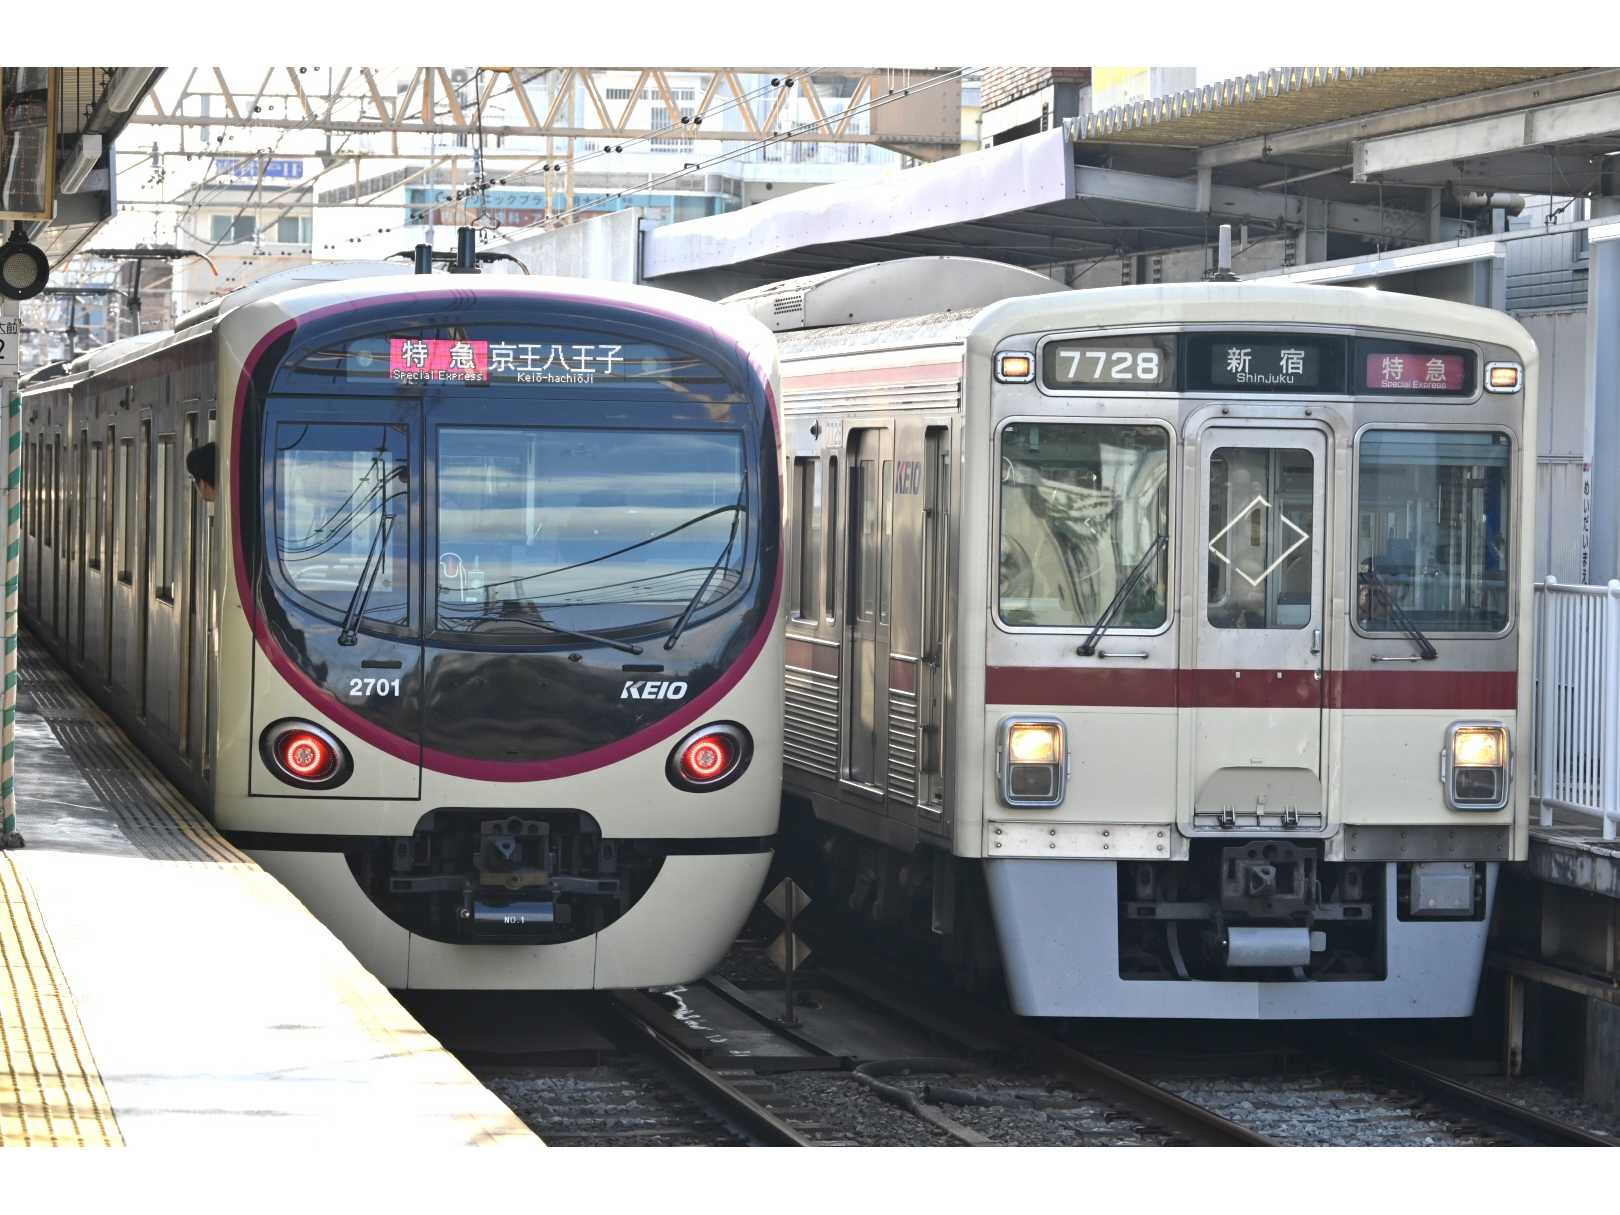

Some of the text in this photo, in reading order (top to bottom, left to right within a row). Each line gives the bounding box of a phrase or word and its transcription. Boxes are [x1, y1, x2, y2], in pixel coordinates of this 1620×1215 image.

[402, 340, 476, 368] 特急
[489, 341, 624, 374] 京王八王子
[1059, 351, 1160, 379] 7728
[1226, 347, 1305, 374] 新宿
[393, 369, 483, 382] Special Express
[1236, 372, 1294, 384] Shinjuku
[1382, 356, 1447, 381] 特急
[1381, 380, 1447, 390] Special Express
[895, 461, 922, 495] KEIO
[349, 678, 401, 697] 2701
[620, 681, 688, 700] KEIO
